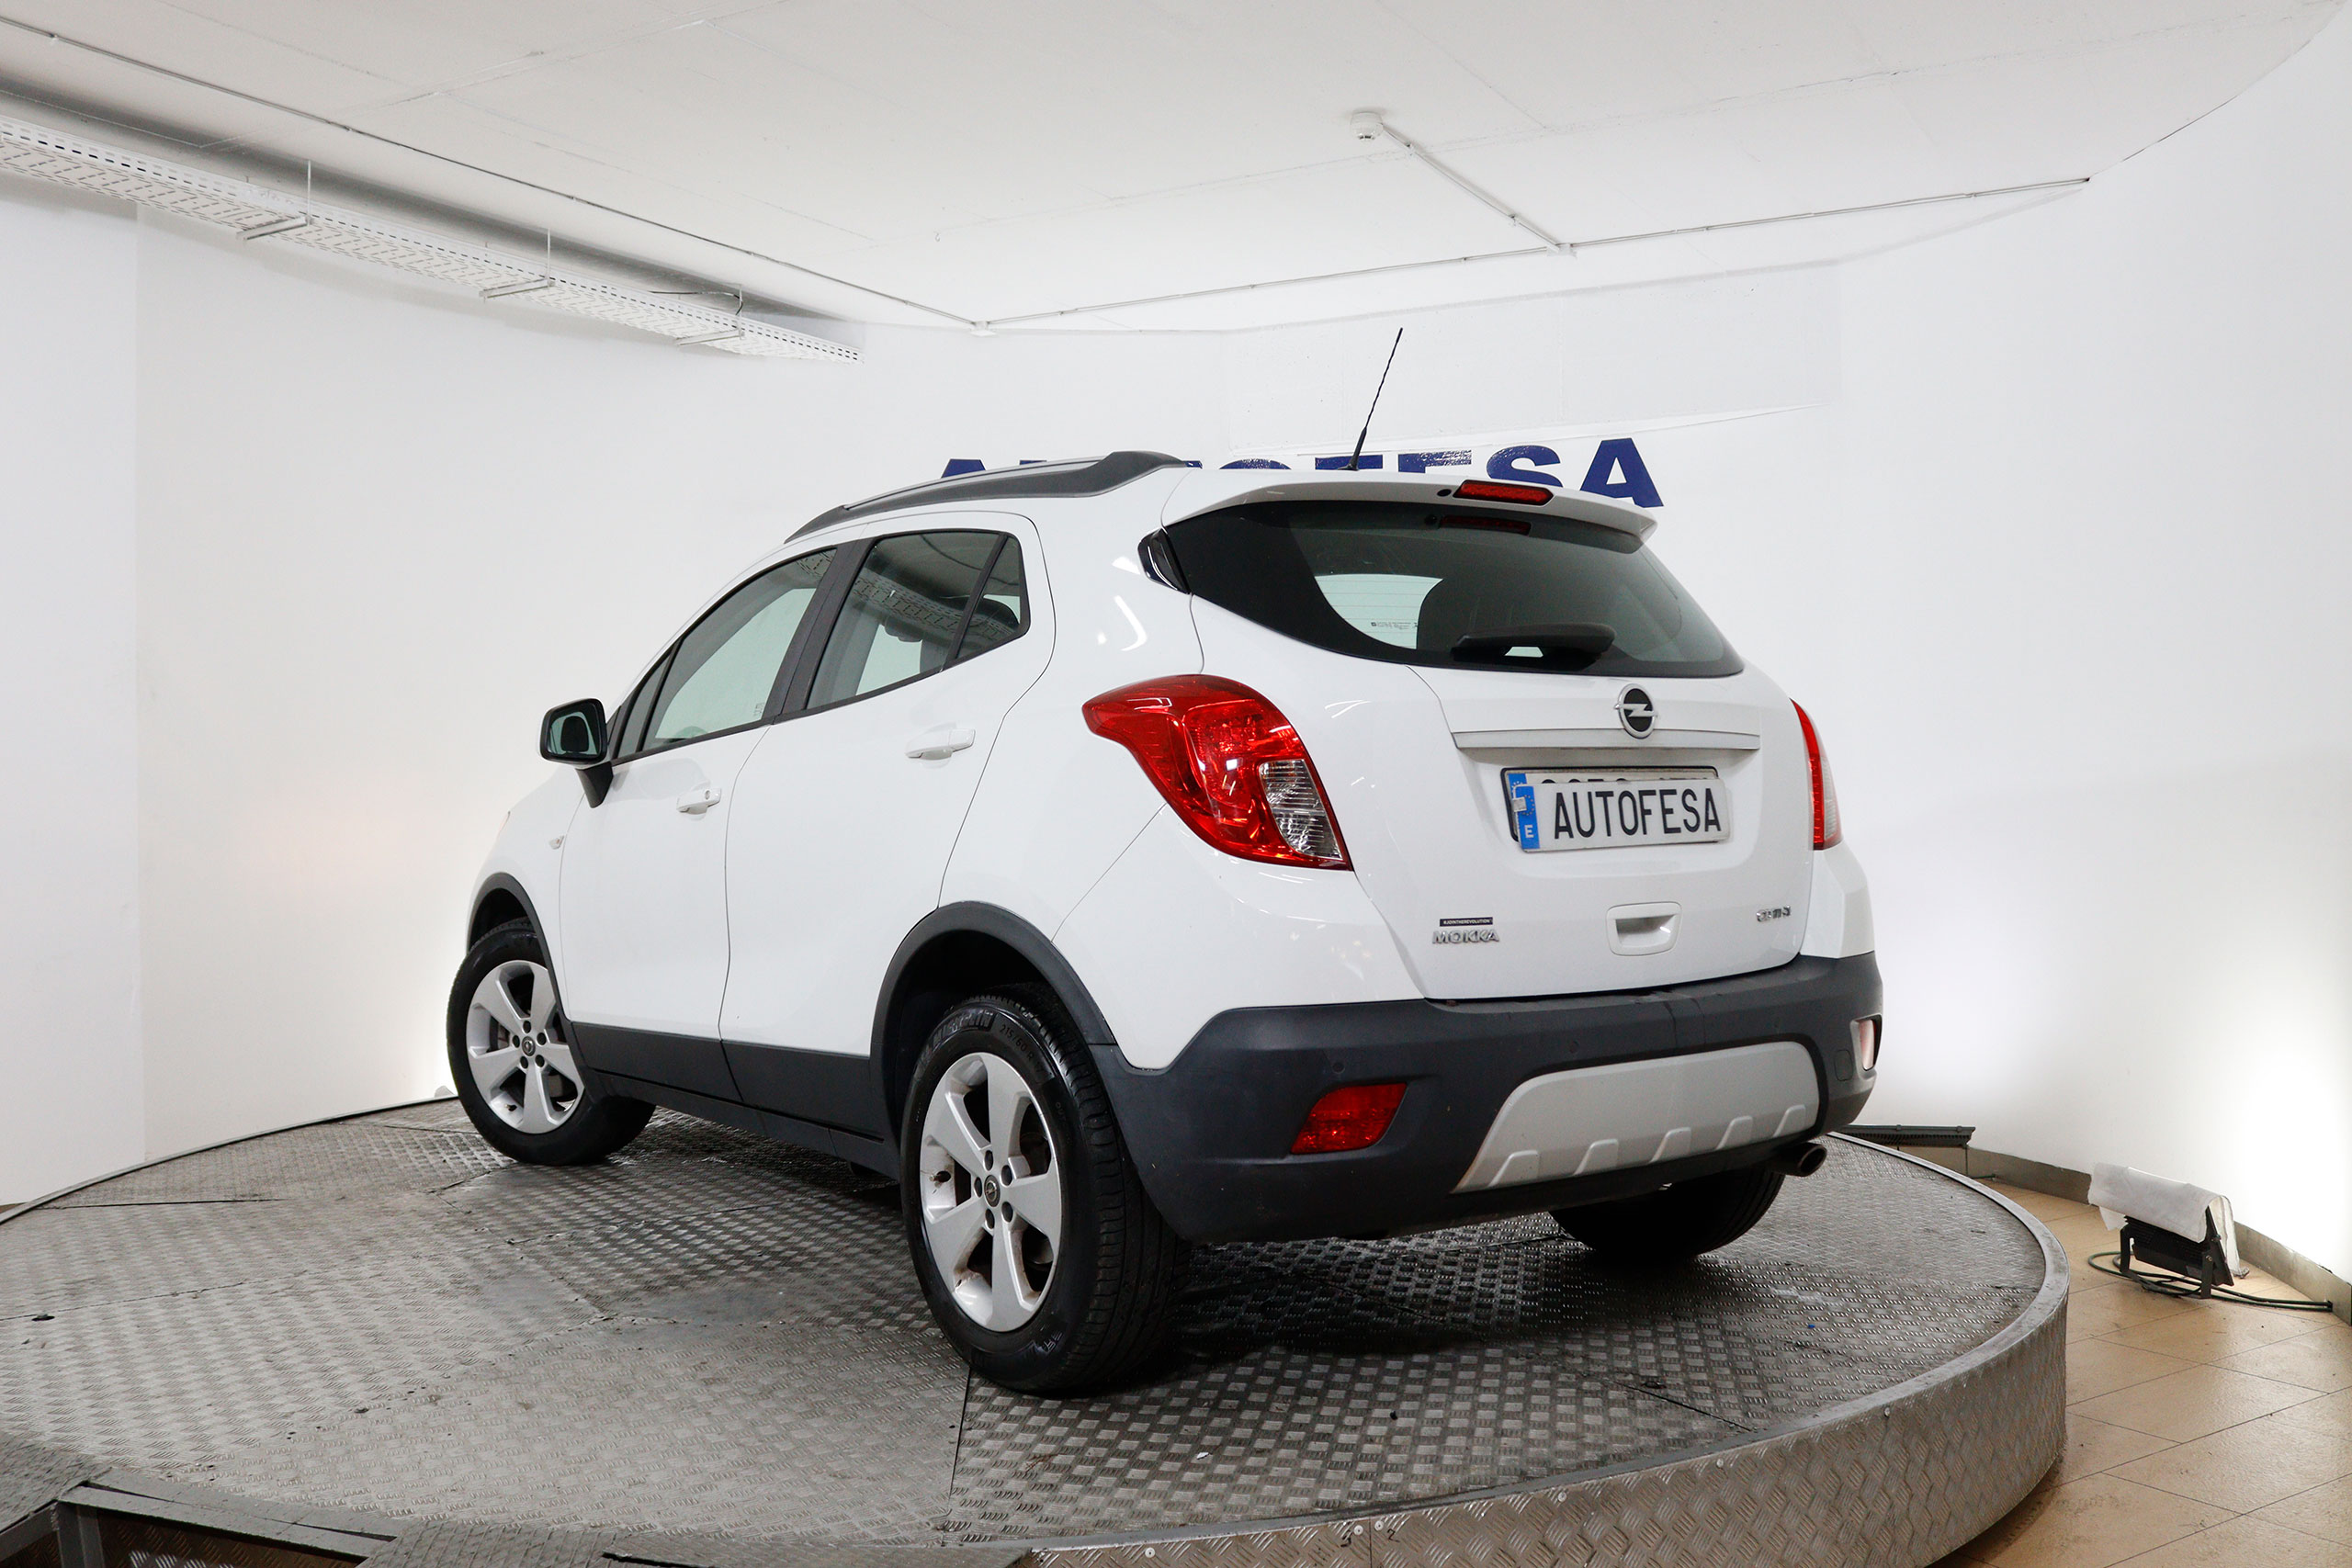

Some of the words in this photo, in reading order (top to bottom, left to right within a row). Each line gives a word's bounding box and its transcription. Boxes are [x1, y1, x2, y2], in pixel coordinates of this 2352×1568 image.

[1555, 788, 1722, 840] AUTOFESA
[1524, 824, 1534, 839] E
[1432, 929, 1500, 944] MOKKA
